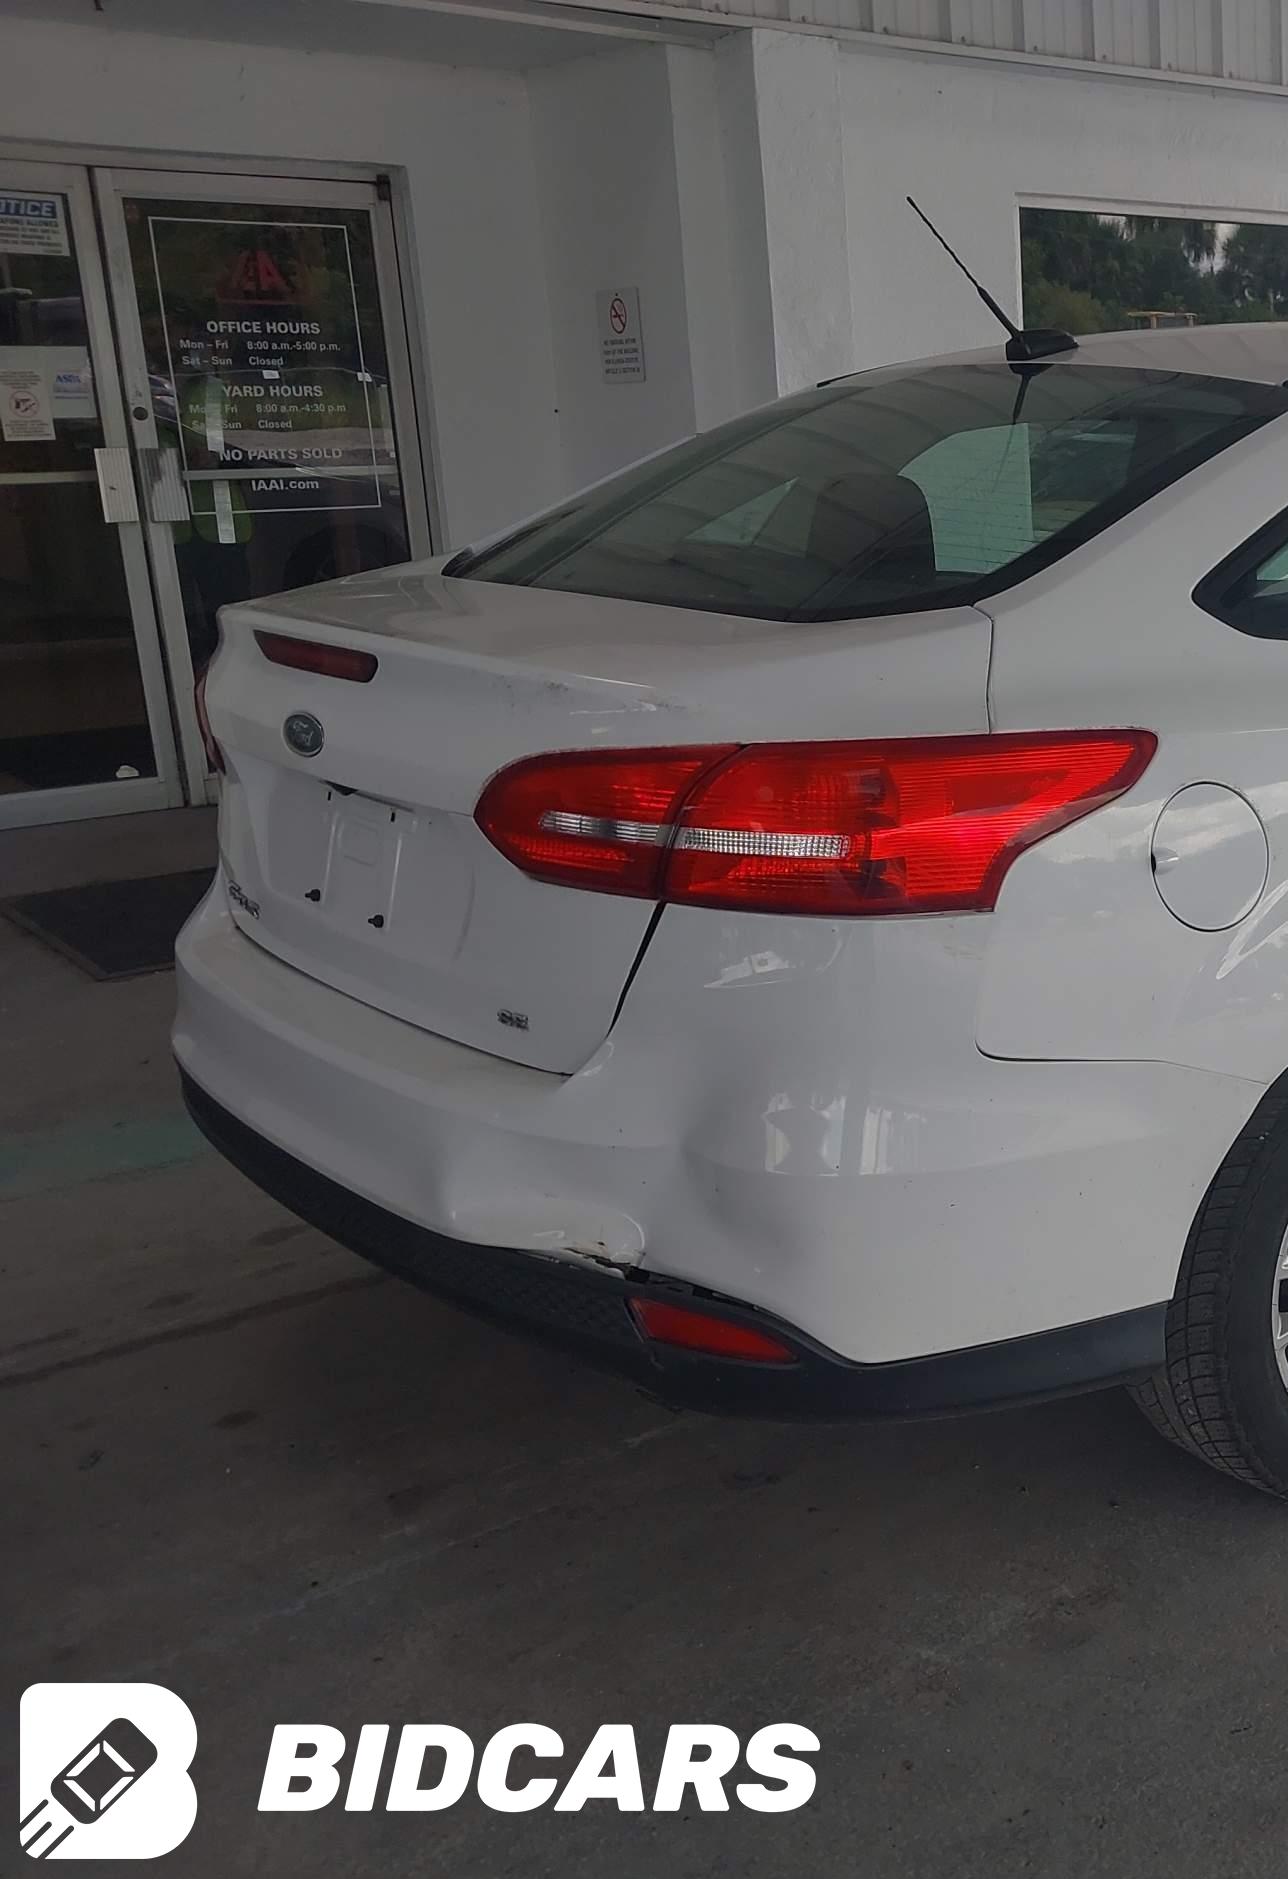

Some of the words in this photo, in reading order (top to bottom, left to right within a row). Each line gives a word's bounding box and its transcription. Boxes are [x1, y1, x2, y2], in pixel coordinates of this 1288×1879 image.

[206, 321, 262, 333] OFFICE
[266, 321, 321, 334] HOURS
[179, 339, 204, 349] Mon
[215, 339, 229, 349] Fri
[247, 341, 269, 351] 8:00
[320, 342, 341, 353] p.m.
[181, 356, 201, 366] Sat
[211, 356, 233, 366] Sun
[248, 355, 284, 366] Closed
[223, 385, 264, 397] YARD
[270, 385, 323, 397] HOURS
[225, 403, 238, 413] Fri
[255, 403, 278, 413] 8:00
[222, 419, 242, 429] Sun
[258, 418, 293, 429] Closed
[220, 450, 242, 462] NO
[248, 448, 298, 461] PARTS
[302, 447, 342, 459] SOLD
[252, 479, 320, 491] IAAI.com
[497, 1008, 528, 1030] SE
